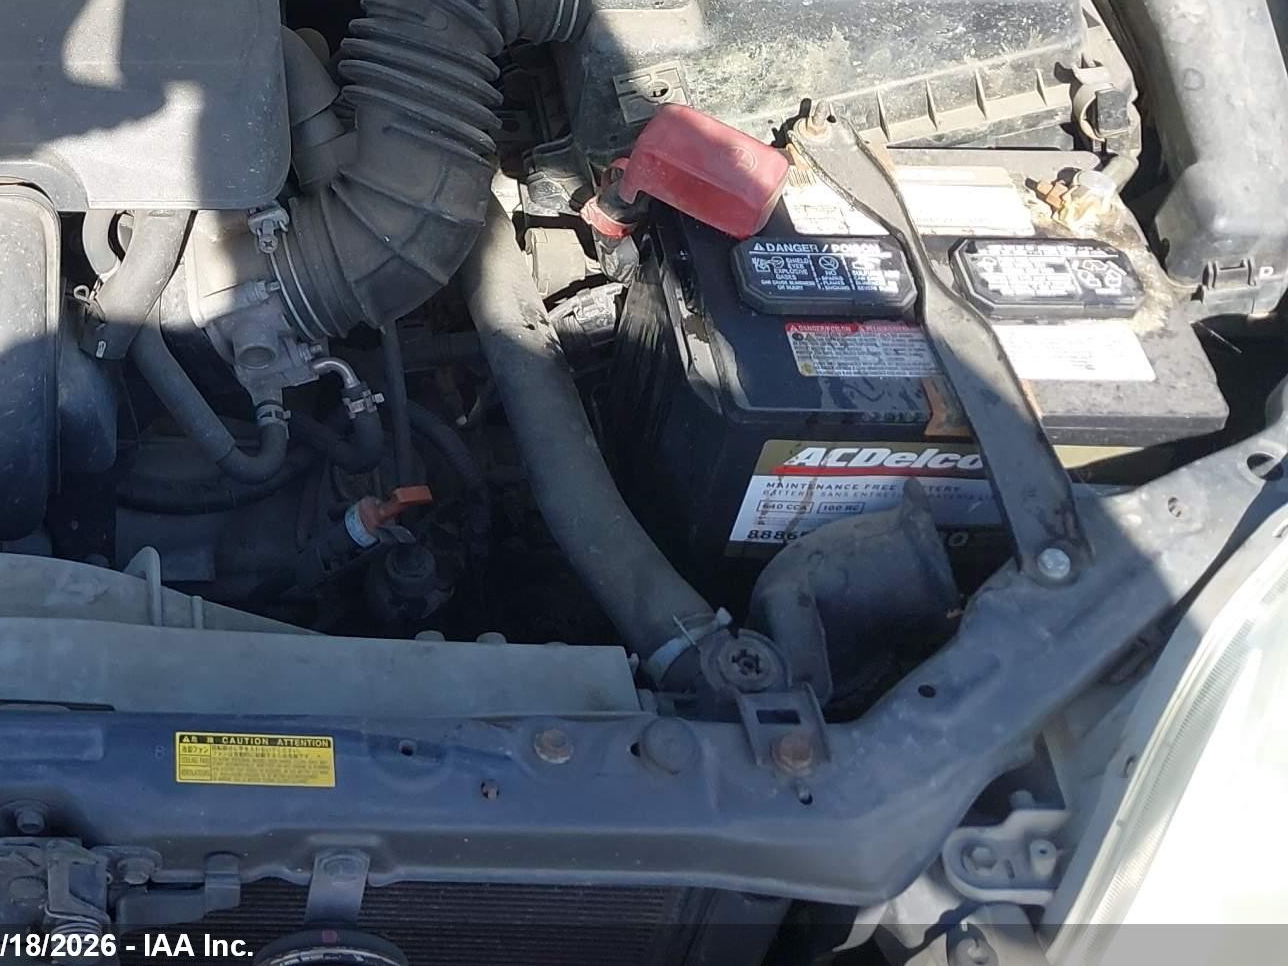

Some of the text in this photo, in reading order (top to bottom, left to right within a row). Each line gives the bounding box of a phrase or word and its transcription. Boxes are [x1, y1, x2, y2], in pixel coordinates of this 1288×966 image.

[766, 242, 819, 253] DANGER
[783, 447, 984, 470] ACDelco
[766, 481, 860, 491] MAINTNANCE
[864, 483, 896, 491] FREE
[746, 528, 806, 541] 8886
[221, 736, 269, 745] CAUTION
[276, 738, 329, 747] ATTENTION
